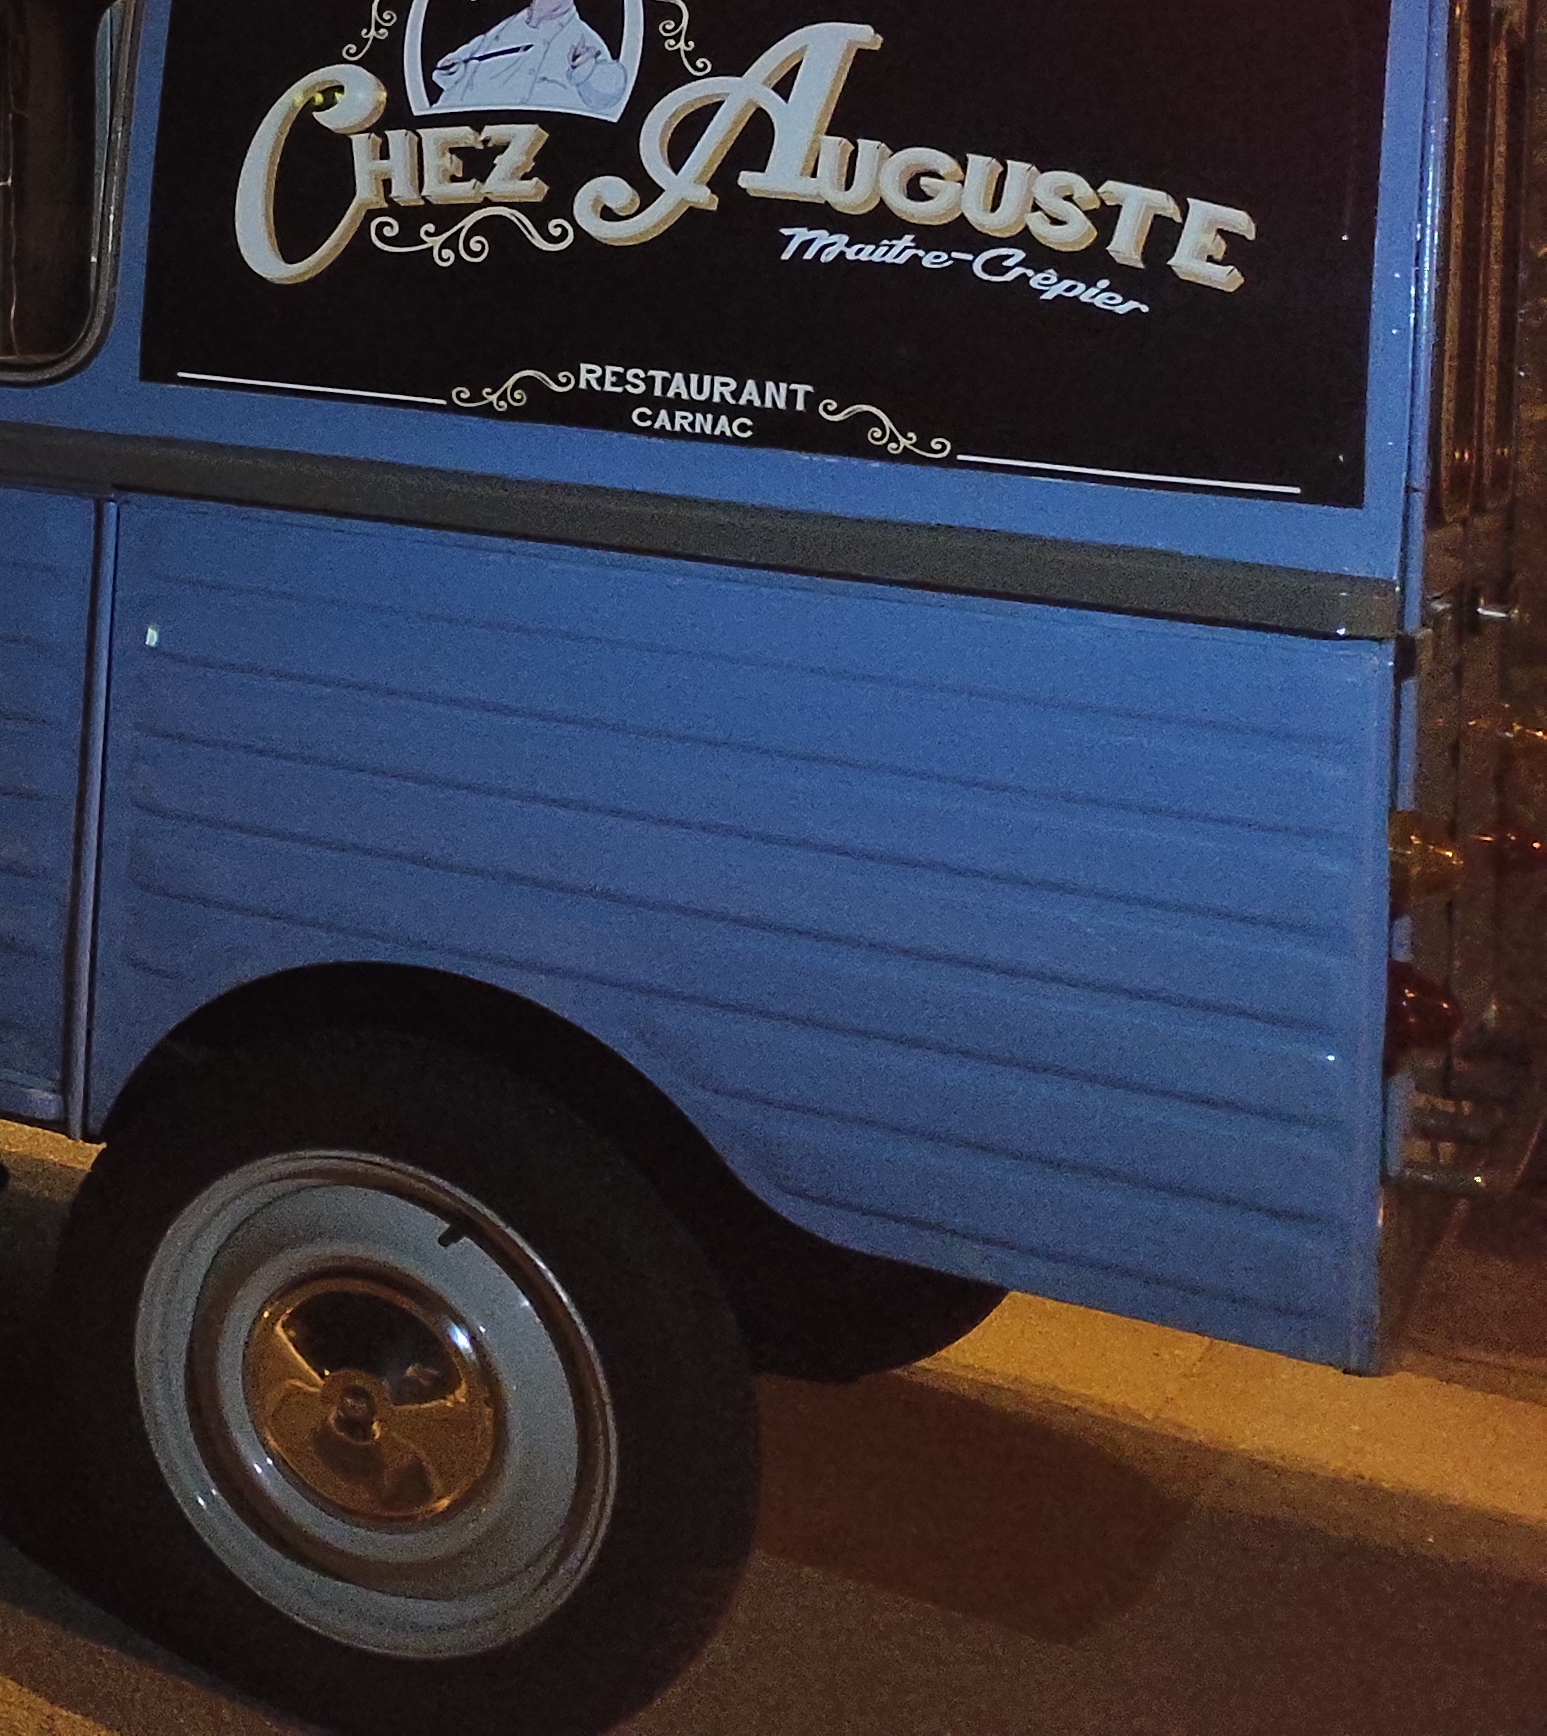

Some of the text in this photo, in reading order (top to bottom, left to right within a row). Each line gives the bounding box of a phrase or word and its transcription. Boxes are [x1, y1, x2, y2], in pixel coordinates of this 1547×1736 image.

[235, 21, 1259, 294] CHEZ AUGUSTE
[578, 363, 814, 411] RESTAURANT
[631, 406, 754, 439] CARNAC
